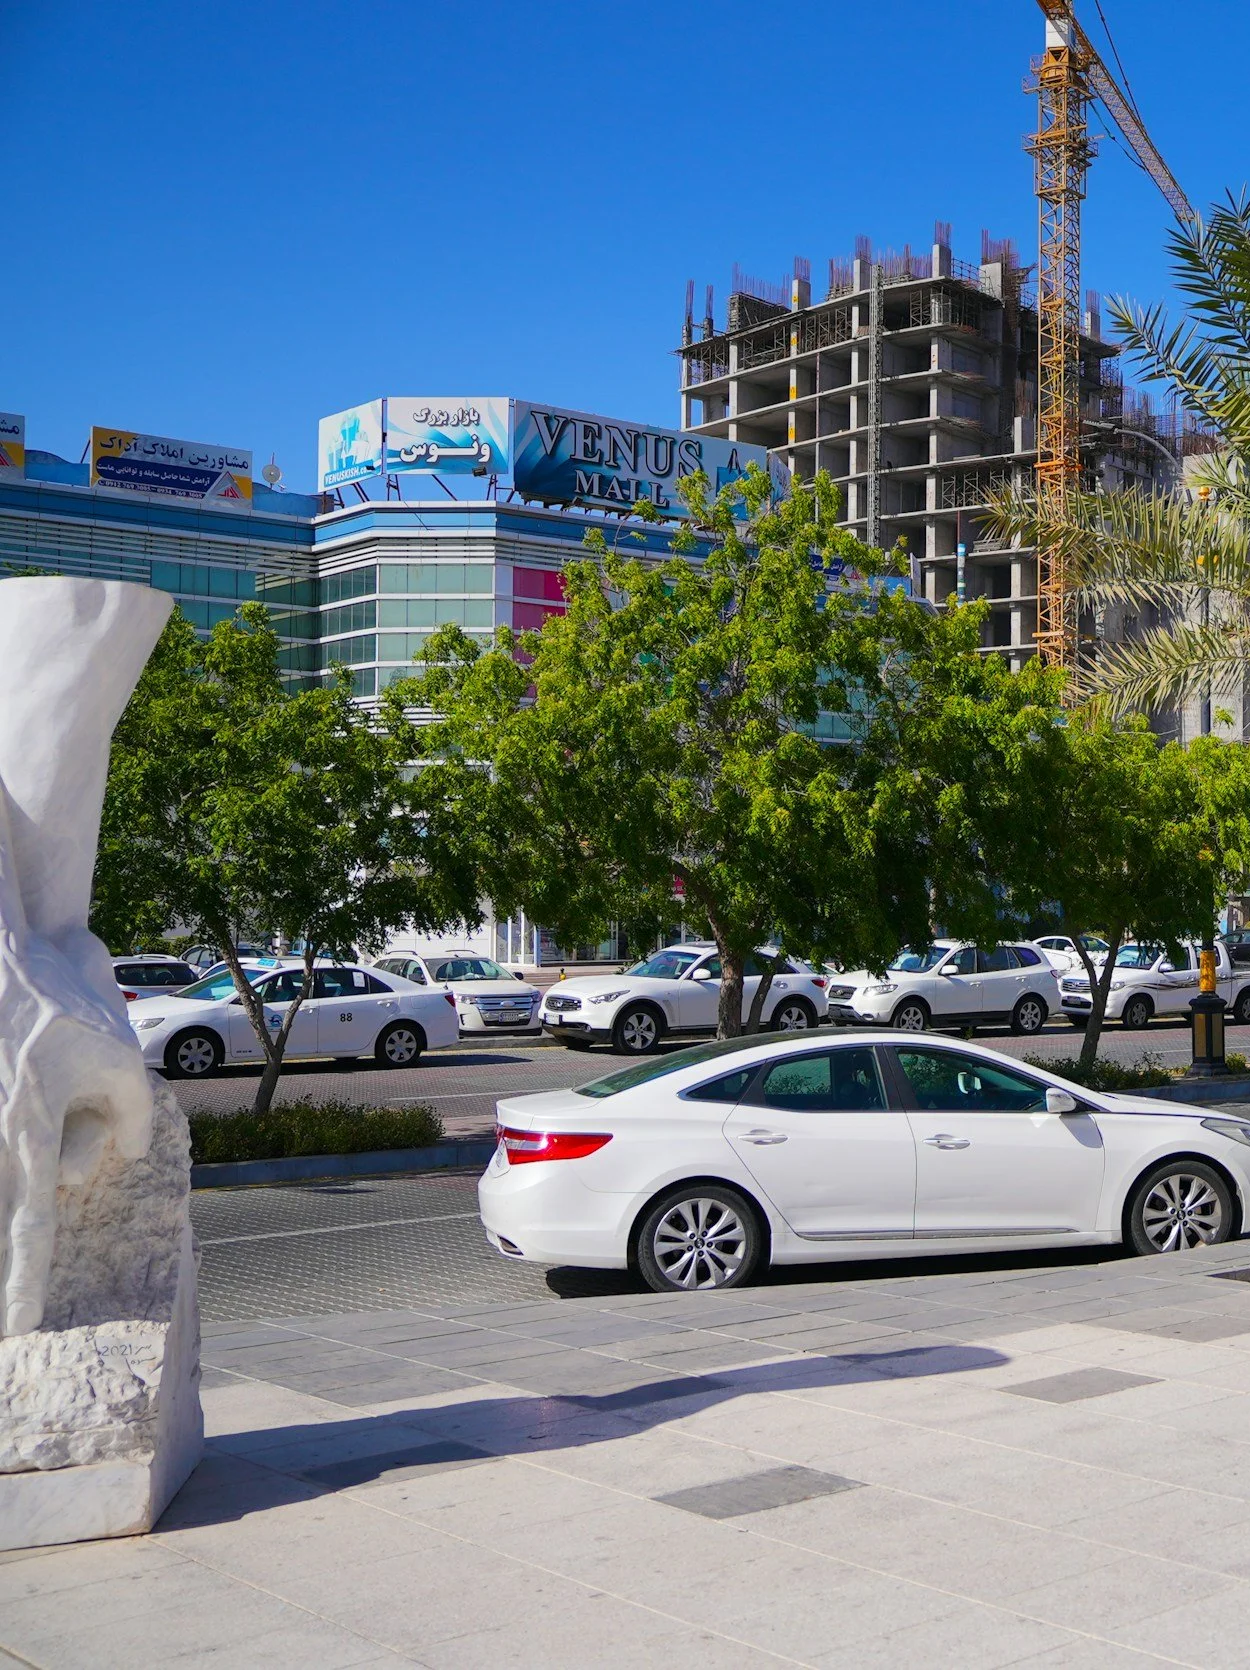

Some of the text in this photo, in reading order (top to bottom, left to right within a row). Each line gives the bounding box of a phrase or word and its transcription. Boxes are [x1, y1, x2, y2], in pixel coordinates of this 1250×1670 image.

[413, 407, 480, 426] بازار بزرگ
[100, 436, 249, 470] مشاورین املاک آداک
[531, 410, 702, 478] VENUS
[324, 465, 374, 485] VENUSKISH.co
[574, 469, 669, 508] MALL
[340, 1012, 353, 1023] 88
[101, 1343, 132, 1357] 2021
